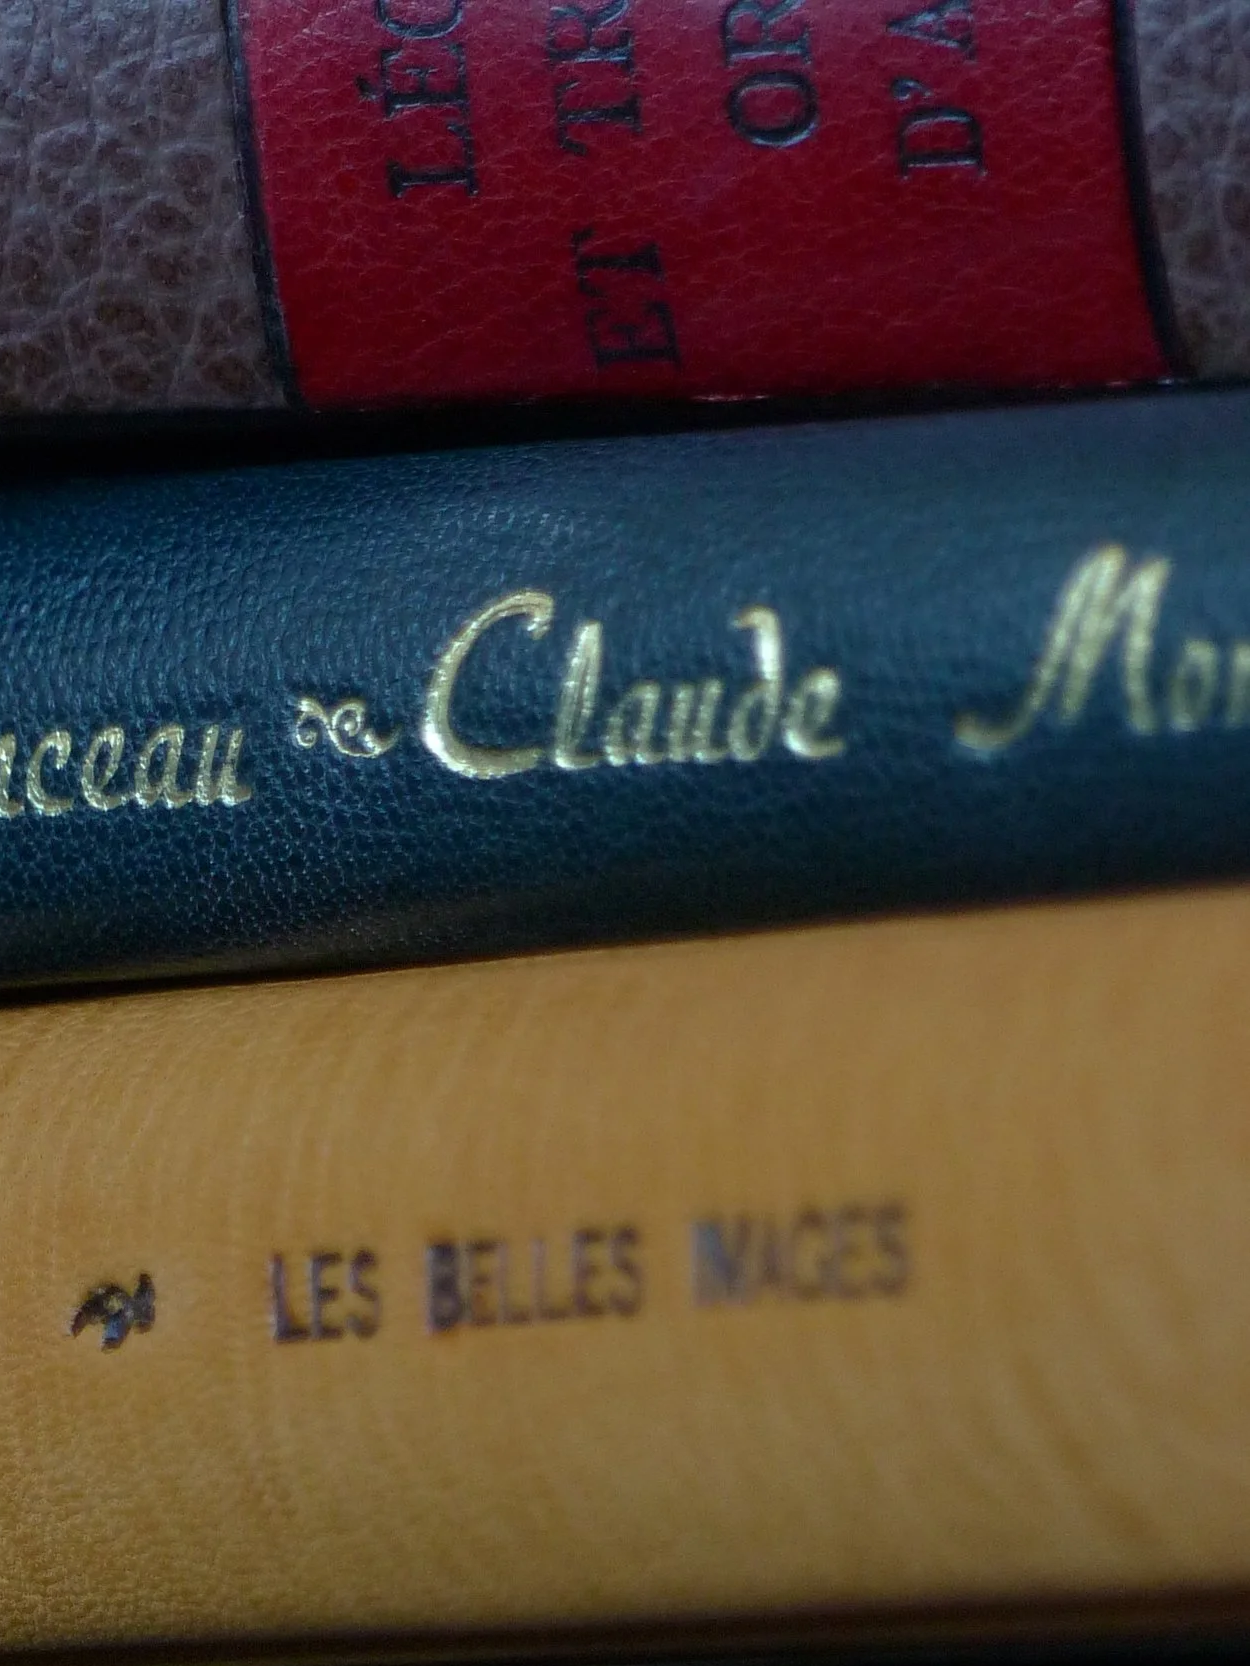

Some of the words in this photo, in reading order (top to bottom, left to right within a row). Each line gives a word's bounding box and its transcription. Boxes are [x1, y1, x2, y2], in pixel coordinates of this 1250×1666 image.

[571, 227, 682, 374] ET
[423, 590, 846, 780] Claude
[269, 1248, 381, 1344] LES
[425, 1223, 645, 1336] BELLES
